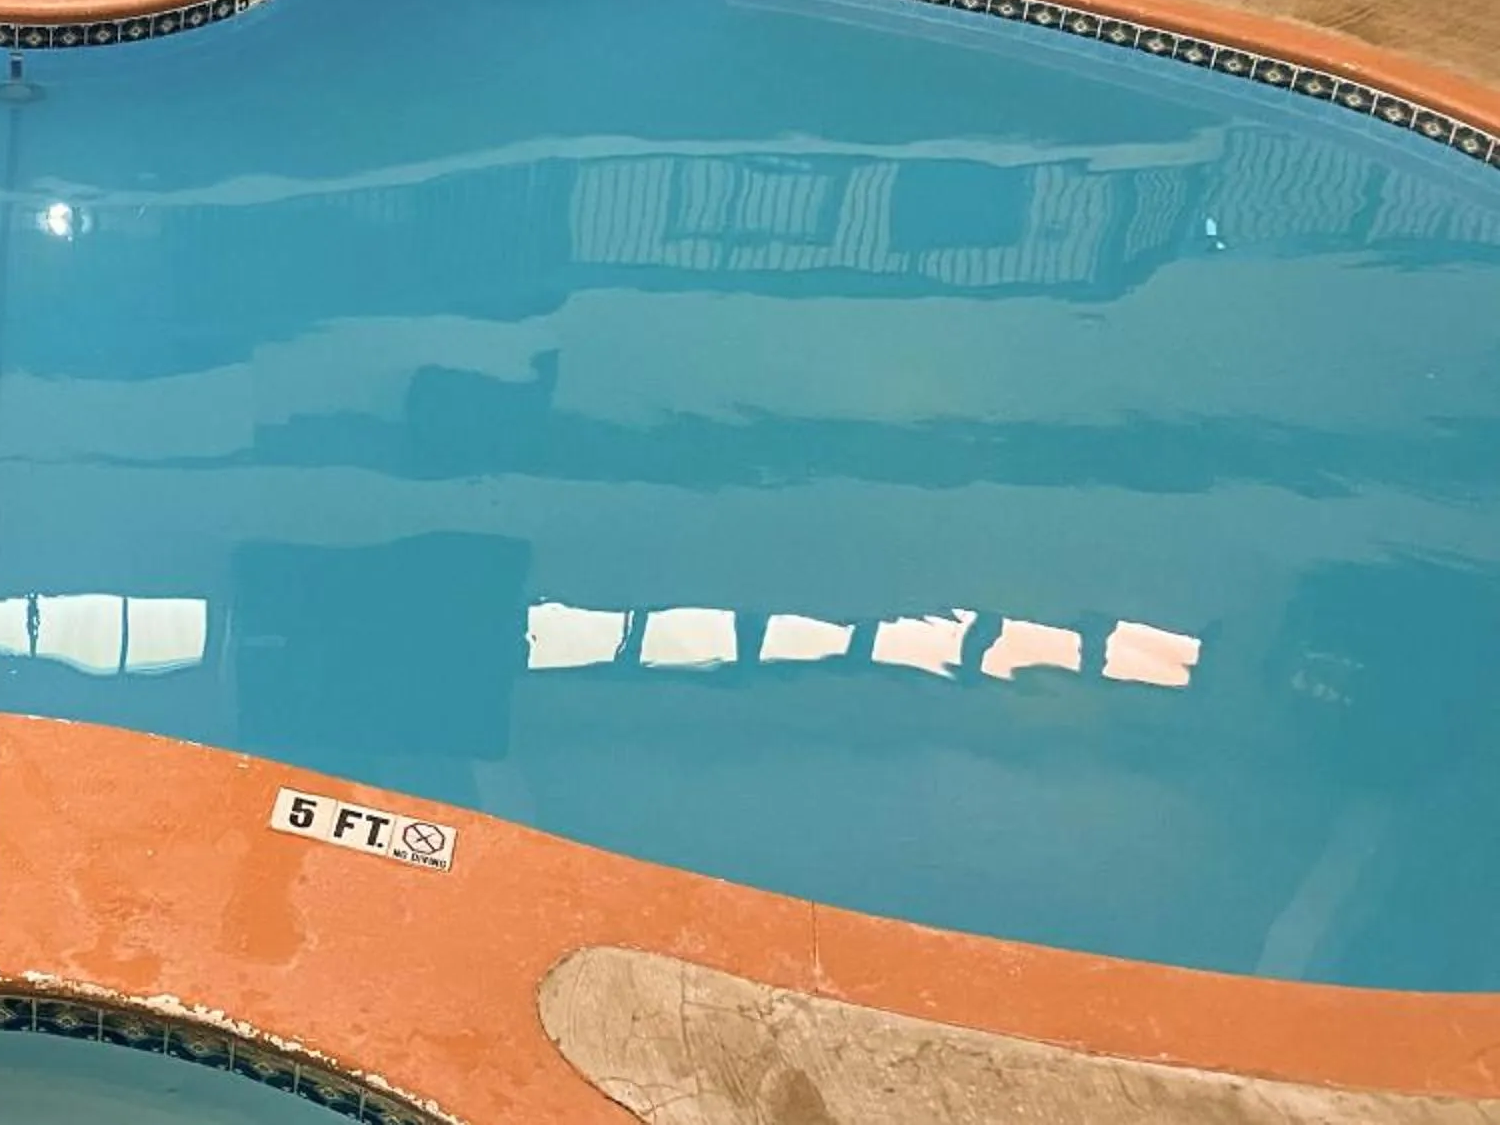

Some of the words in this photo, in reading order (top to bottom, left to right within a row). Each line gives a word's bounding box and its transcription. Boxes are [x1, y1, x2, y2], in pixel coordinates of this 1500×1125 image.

[288, 797, 318, 829] 5
[333, 808, 390, 849] FT.
[393, 849, 408, 860] NO
[410, 852, 448, 869] DIVING
